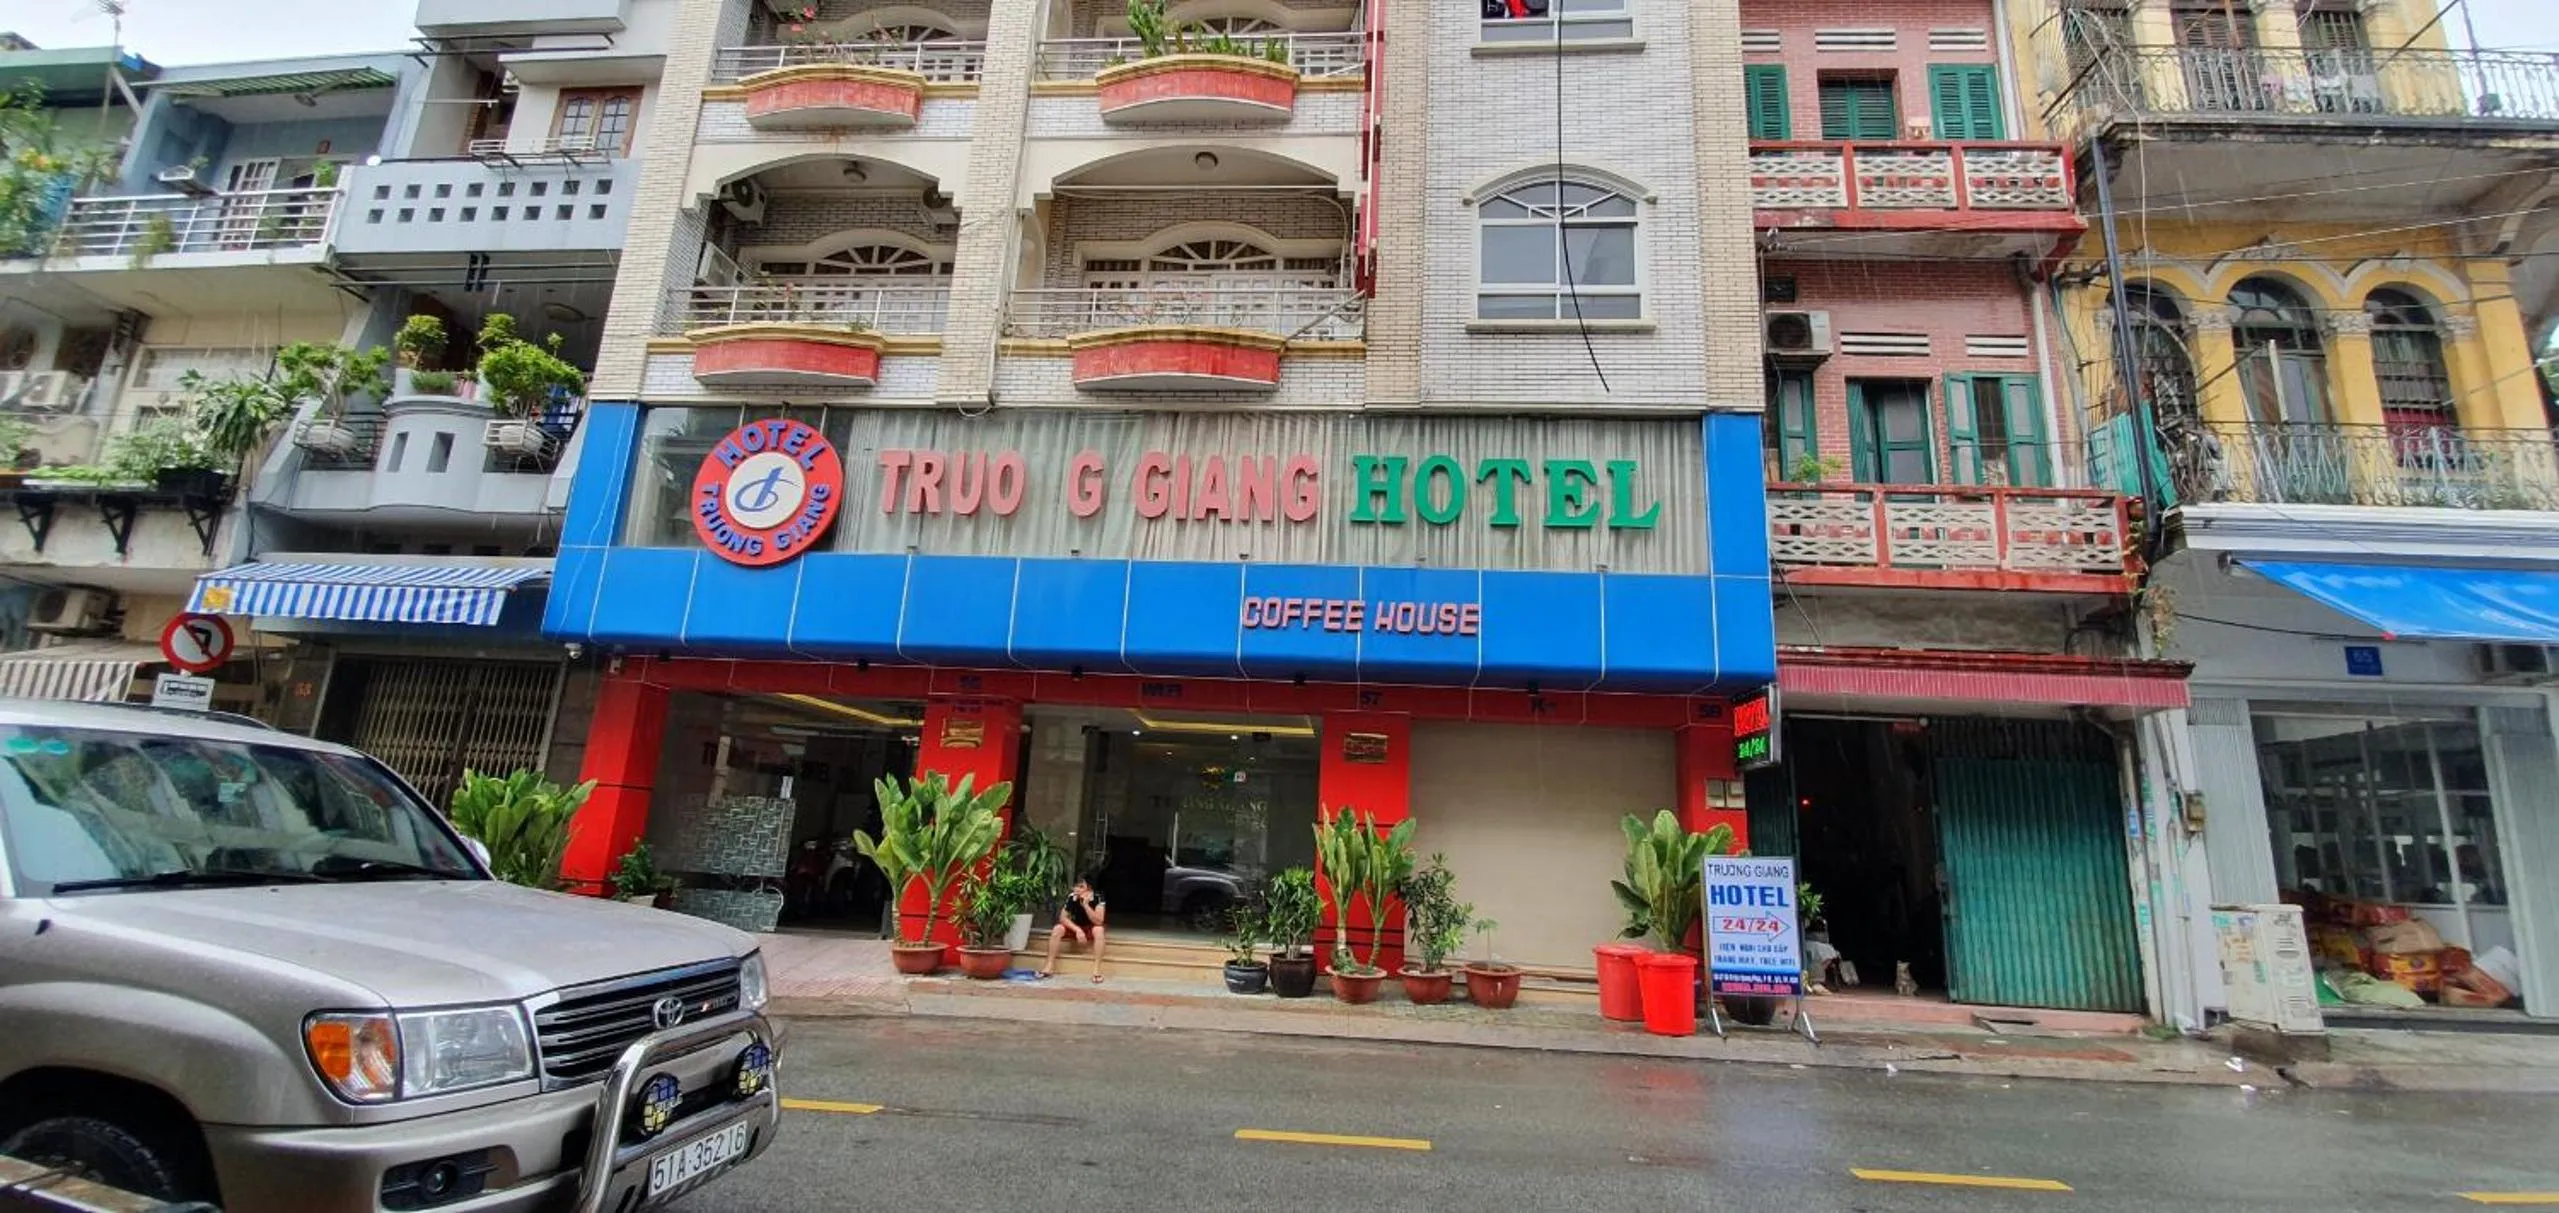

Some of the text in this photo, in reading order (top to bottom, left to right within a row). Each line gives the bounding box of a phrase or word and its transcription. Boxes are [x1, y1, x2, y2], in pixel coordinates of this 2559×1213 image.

[714, 420, 826, 471] HOTEL
[1134, 451, 1320, 524] GIANG
[1350, 454, 1661, 528] HOTEL
[774, 483, 831, 550] GIANG
[1242, 596, 1480, 635] COFFEE HOUSE
[1754, 866, 1790, 879] GIANG
[1710, 885, 1791, 908] HOTEL
[1723, 919, 1780, 933] 24/24
